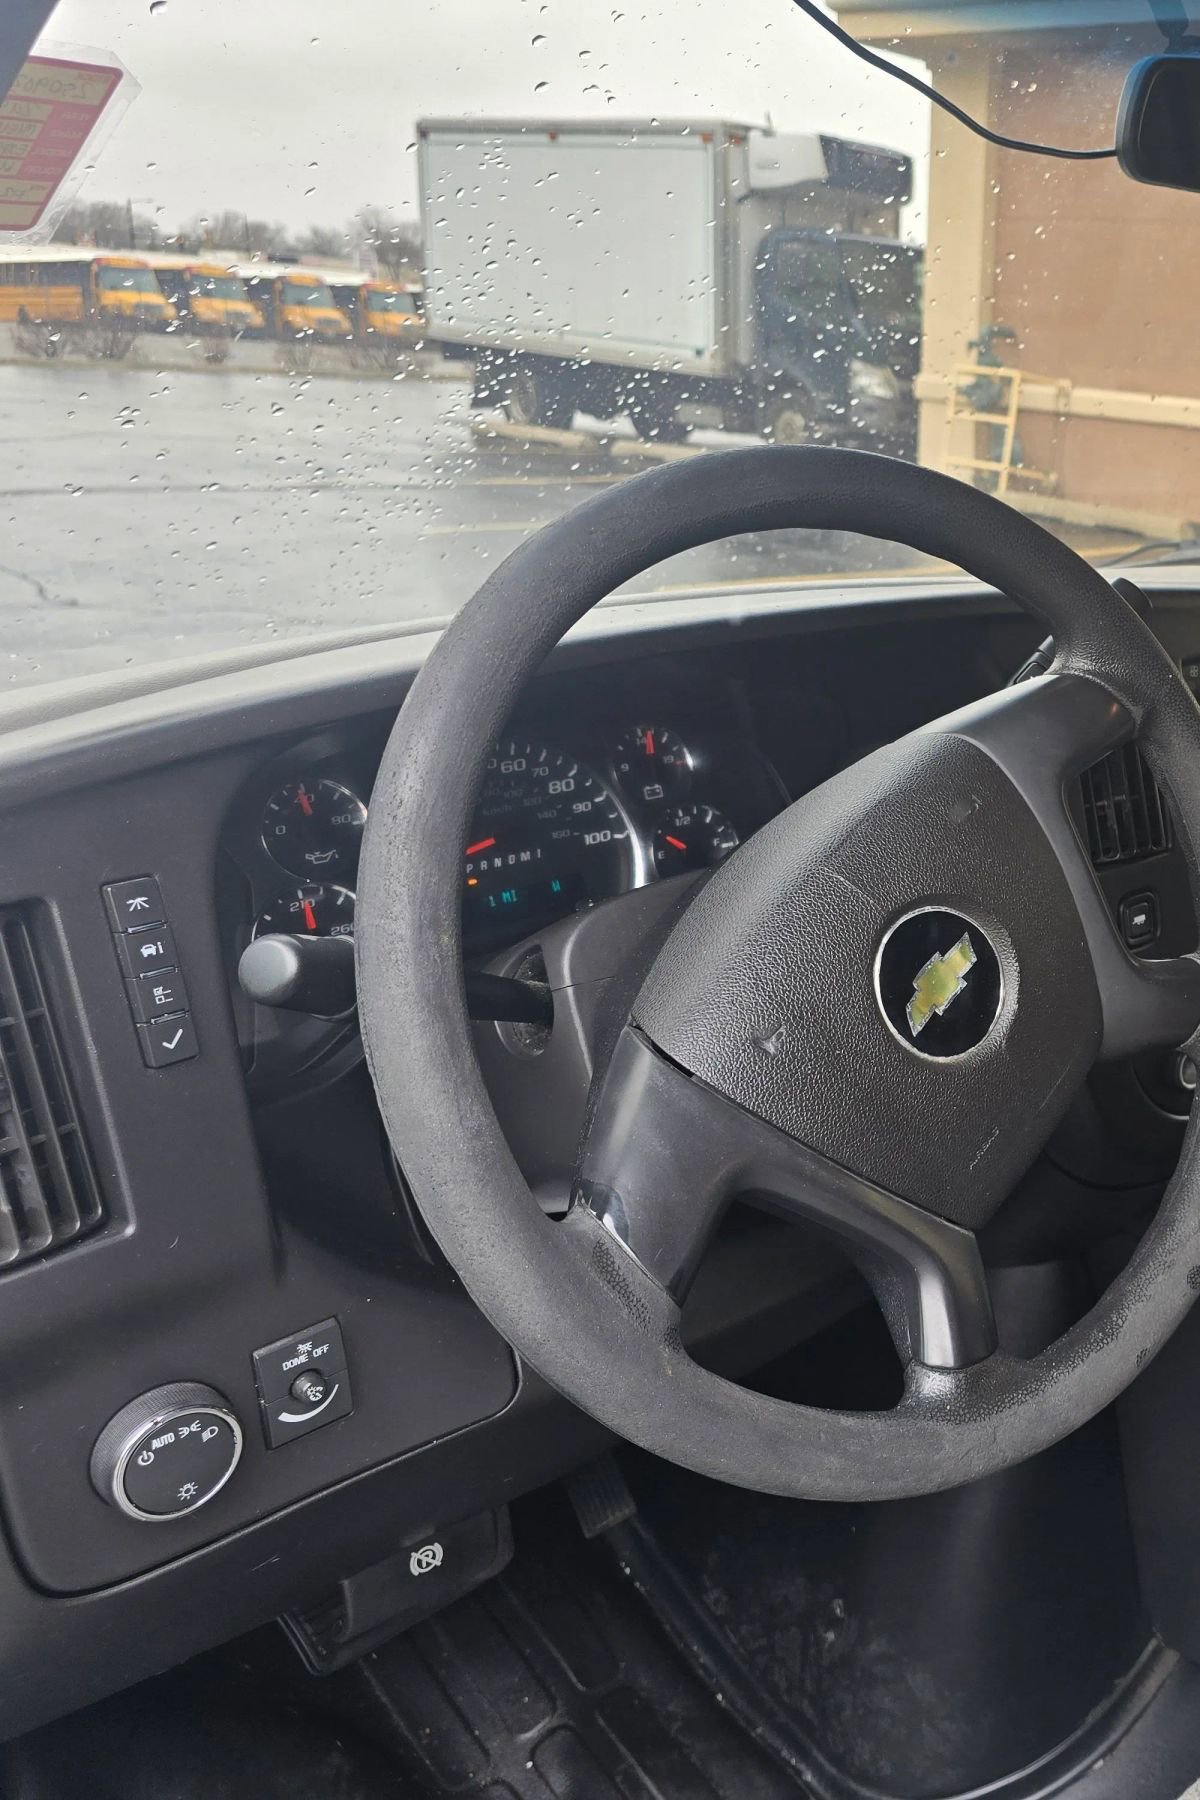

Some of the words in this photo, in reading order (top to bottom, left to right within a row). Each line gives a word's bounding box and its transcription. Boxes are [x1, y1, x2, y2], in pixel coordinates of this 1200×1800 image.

[500, 758, 527, 773] 60
[620, 763, 630, 773] 9
[531, 766, 549, 778] 70
[548, 778, 575, 794] 80
[572, 801, 592, 814] 90
[330, 814, 351, 825] 80
[275, 825, 287, 835] 0
[584, 830, 612, 846] 100
[713, 838, 721, 847] F
[657, 850, 665, 860] E
[282, 1354, 309, 1371] DOME
[312, 1343, 330, 1358] OFF
[151, 1432, 175, 1450] AUTO
